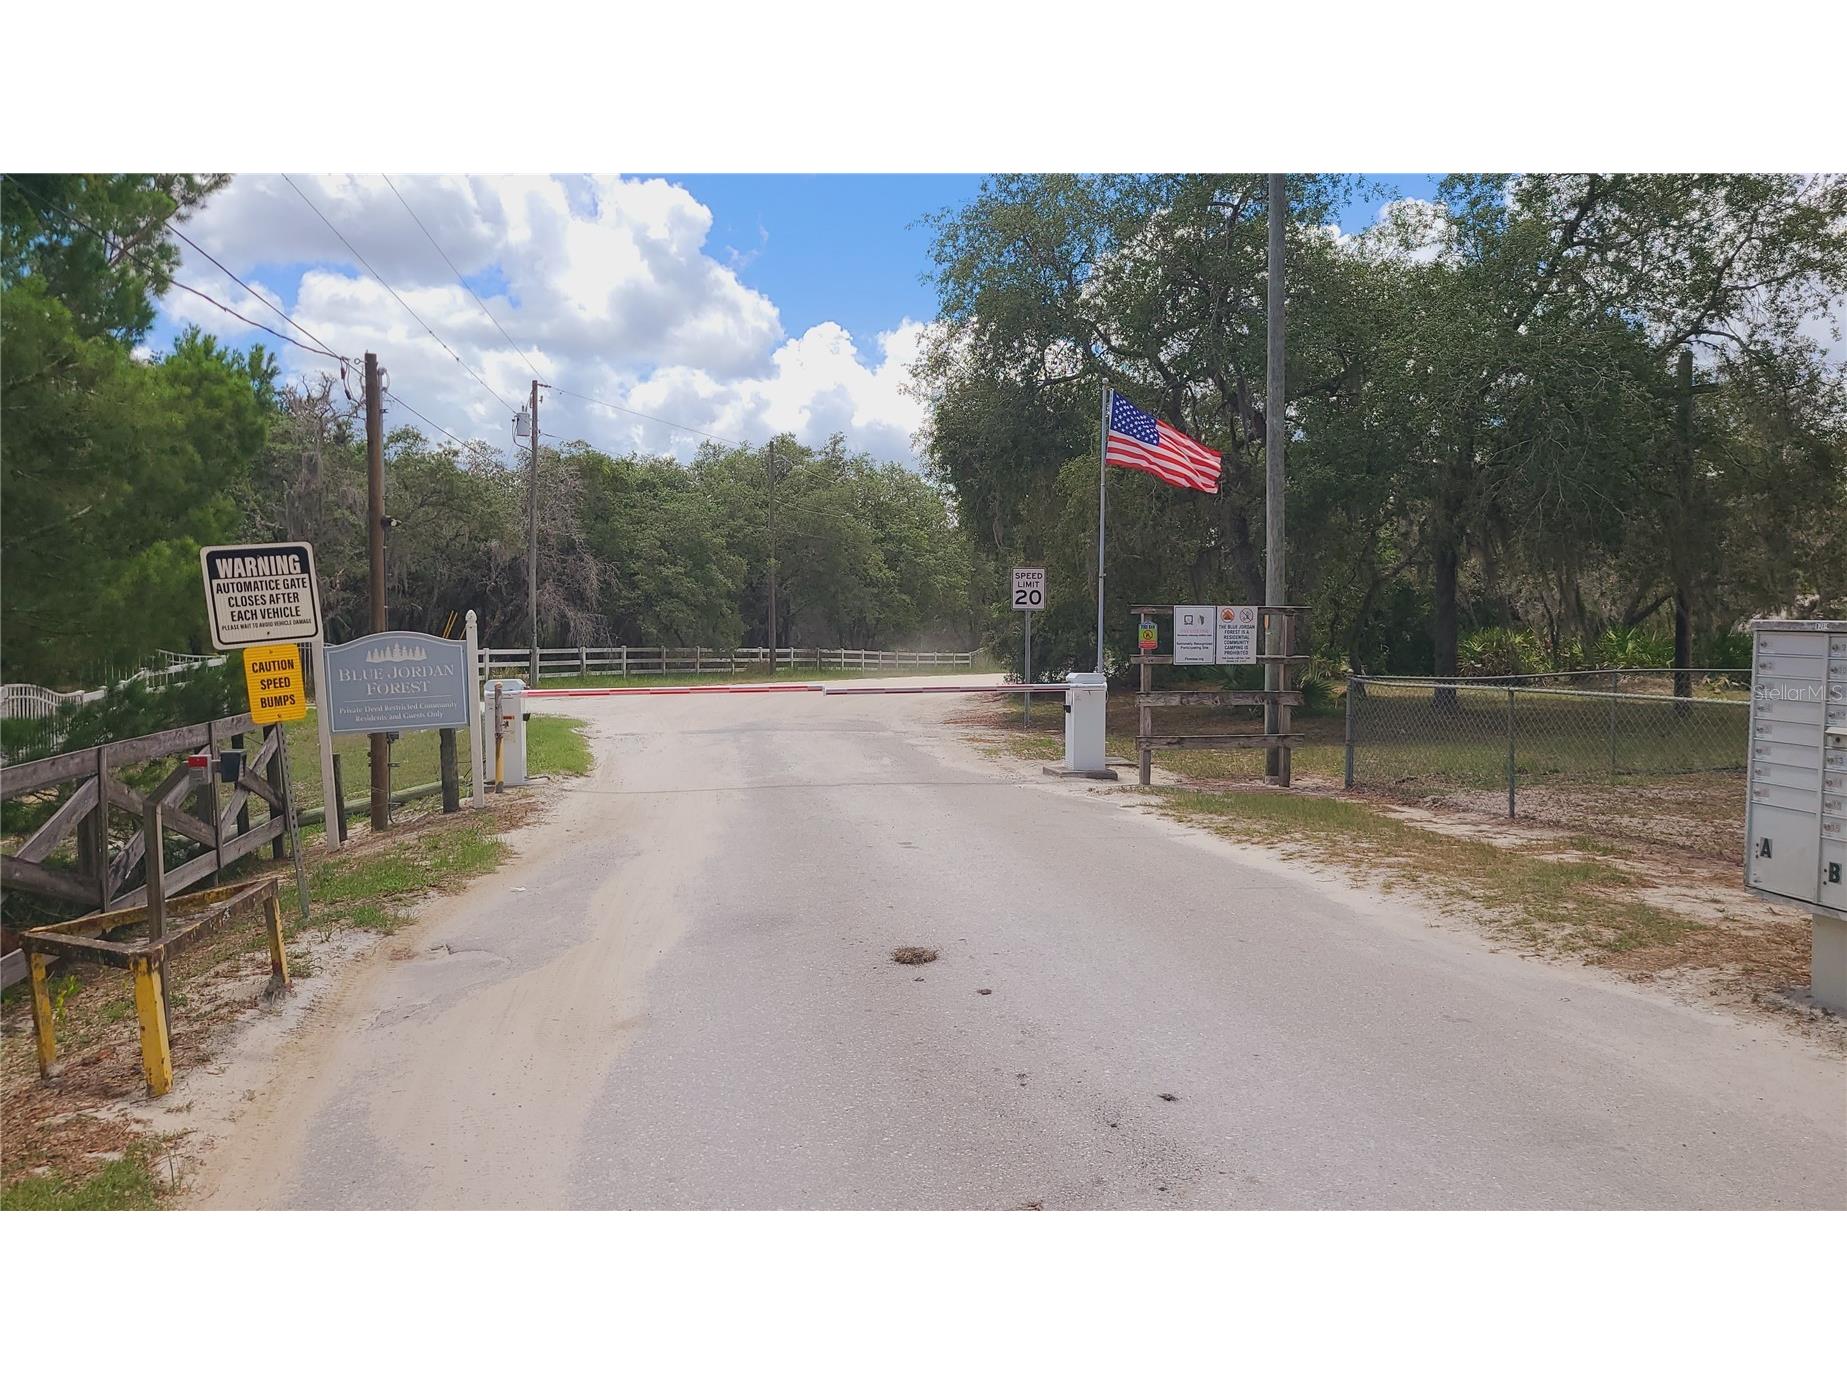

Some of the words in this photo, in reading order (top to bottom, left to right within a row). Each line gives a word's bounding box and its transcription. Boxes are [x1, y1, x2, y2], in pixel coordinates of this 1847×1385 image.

[216, 554, 301, 578] WARNING
[216, 579, 280, 594] AUTOMATICE
[283, 578, 308, 589] GATE
[228, 594, 266, 608] CLOSES
[269, 592, 300, 605] AFTER
[1015, 590, 1041, 605] 20
[230, 609, 258, 622] EACH
[260, 606, 301, 620] VEHICLE
[252, 659, 294, 673] CAUTION
[339, 668, 383, 681] BLUE
[388, 664, 454, 679] JORDAN
[260, 677, 290, 690] SPEED
[367, 681, 430, 695] FOREST
[260, 694, 296, 708] BUMPS
[384, 703, 418, 712] Restricted
[427, 710, 443, 718] Only
[1760, 838, 1772, 858] A
[1829, 862, 1840, 883] B
